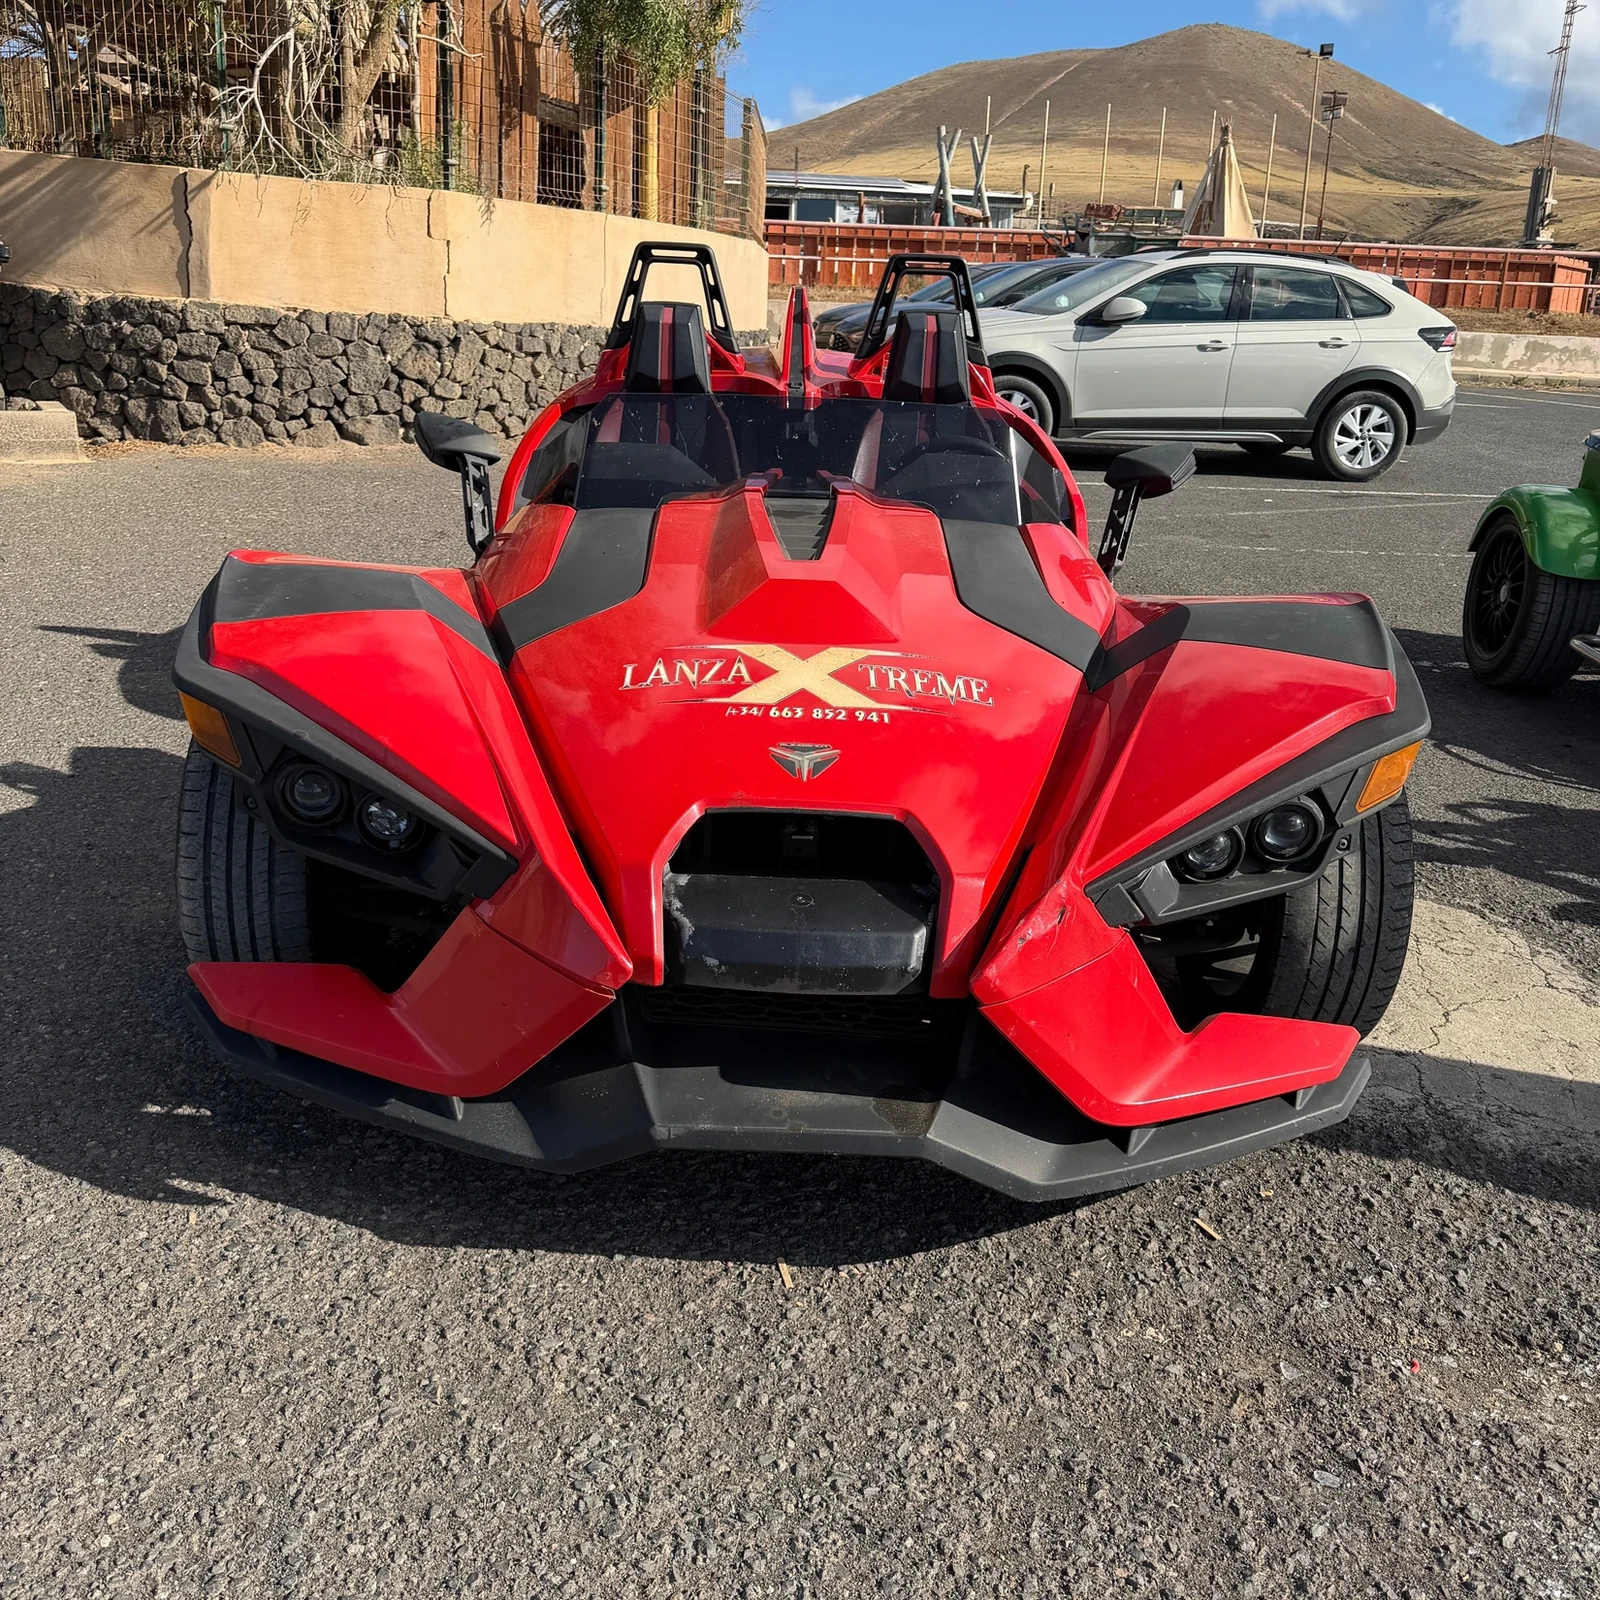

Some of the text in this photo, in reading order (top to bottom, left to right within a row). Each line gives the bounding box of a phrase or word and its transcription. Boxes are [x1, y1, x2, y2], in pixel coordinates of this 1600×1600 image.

[619, 655, 754, 690] LANZA
[769, 706, 804, 718] 663
[812, 708, 847, 721] 852
[854, 710, 890, 724] 941
